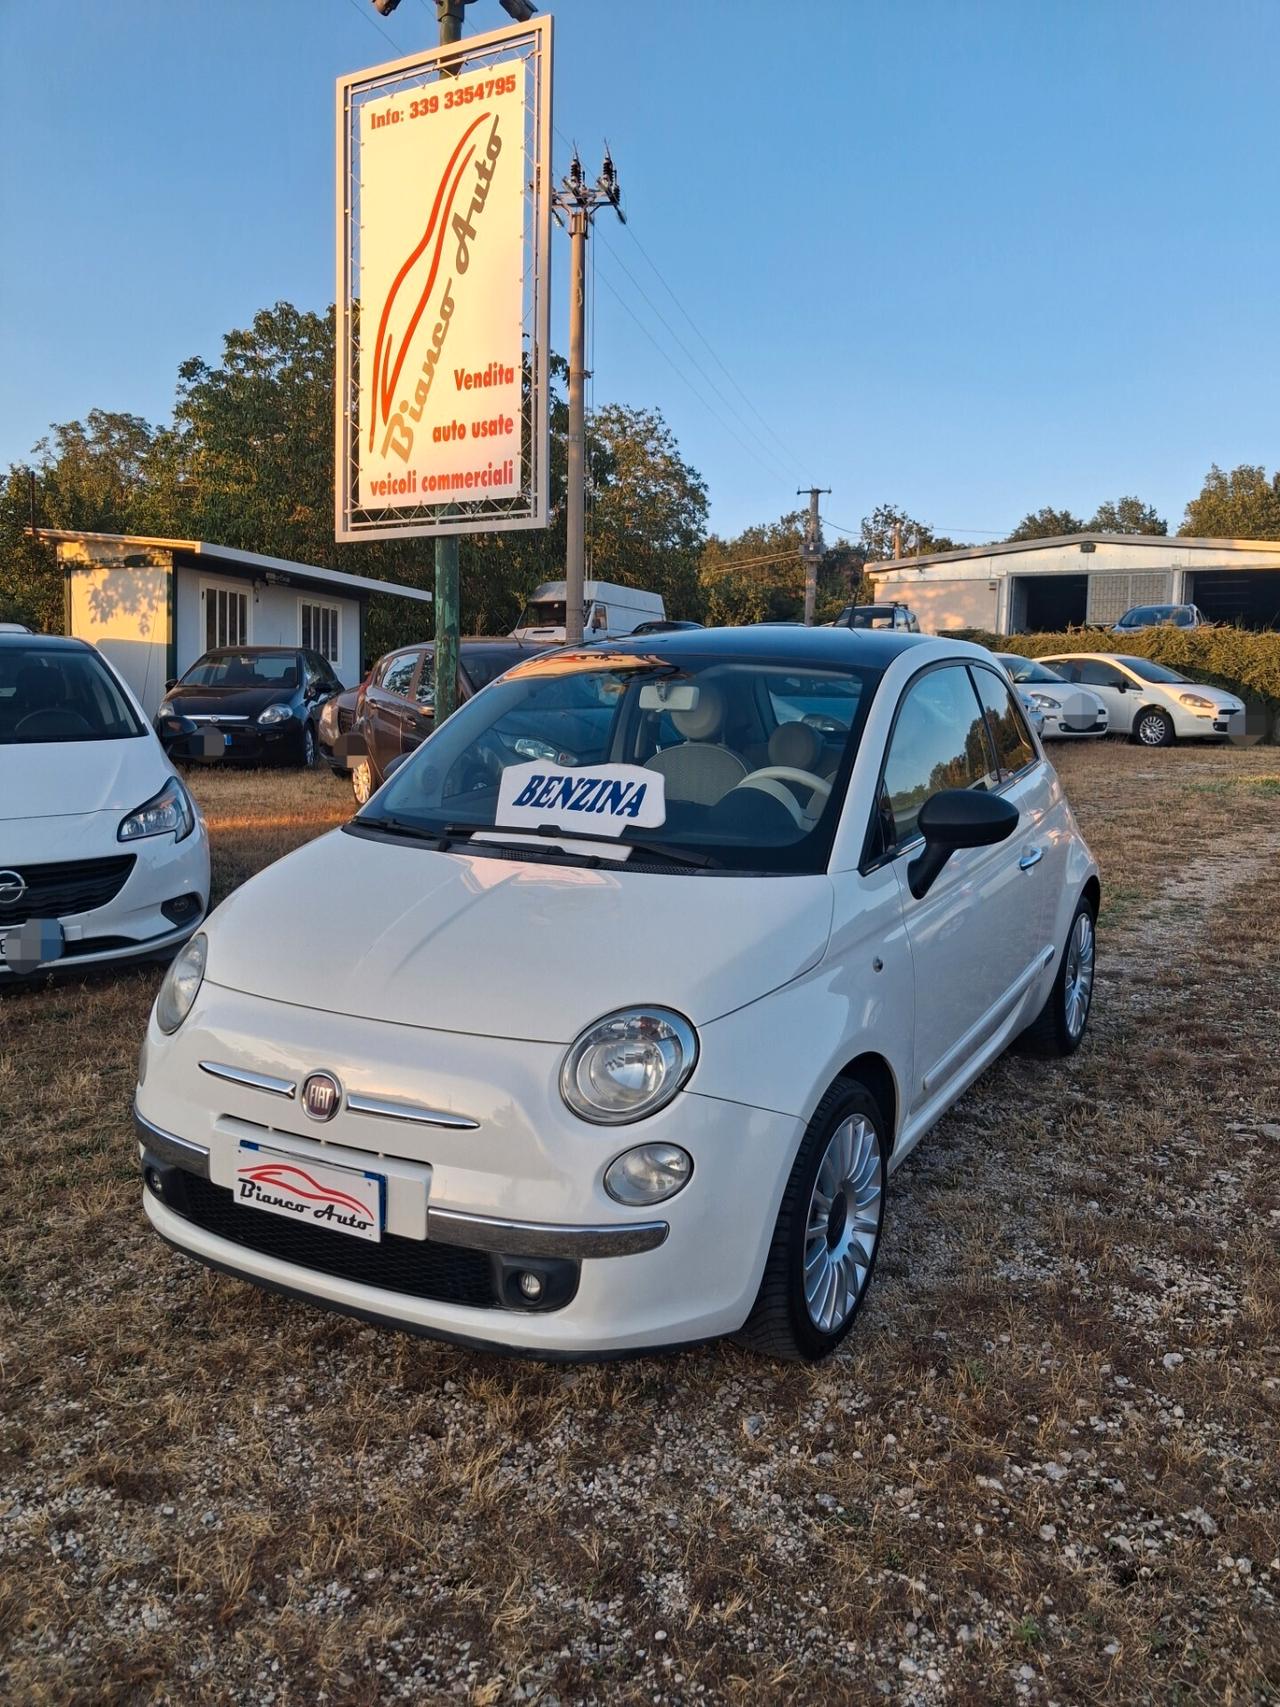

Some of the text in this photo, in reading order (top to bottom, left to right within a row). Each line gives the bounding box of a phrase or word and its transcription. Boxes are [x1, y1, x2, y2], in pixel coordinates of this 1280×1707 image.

[370, 74, 516, 130] Info: 339 3354795
[380, 114, 502, 464] Bianco Auto
[454, 361, 515, 391] Vendita
[432, 414, 514, 443] auto usate
[370, 460, 514, 497] veicoli commerciali
[511, 774, 648, 818] BENZINA
[310, 1084, 333, 1110] FIAT
[238, 1177, 375, 1231] Bianco Auto
